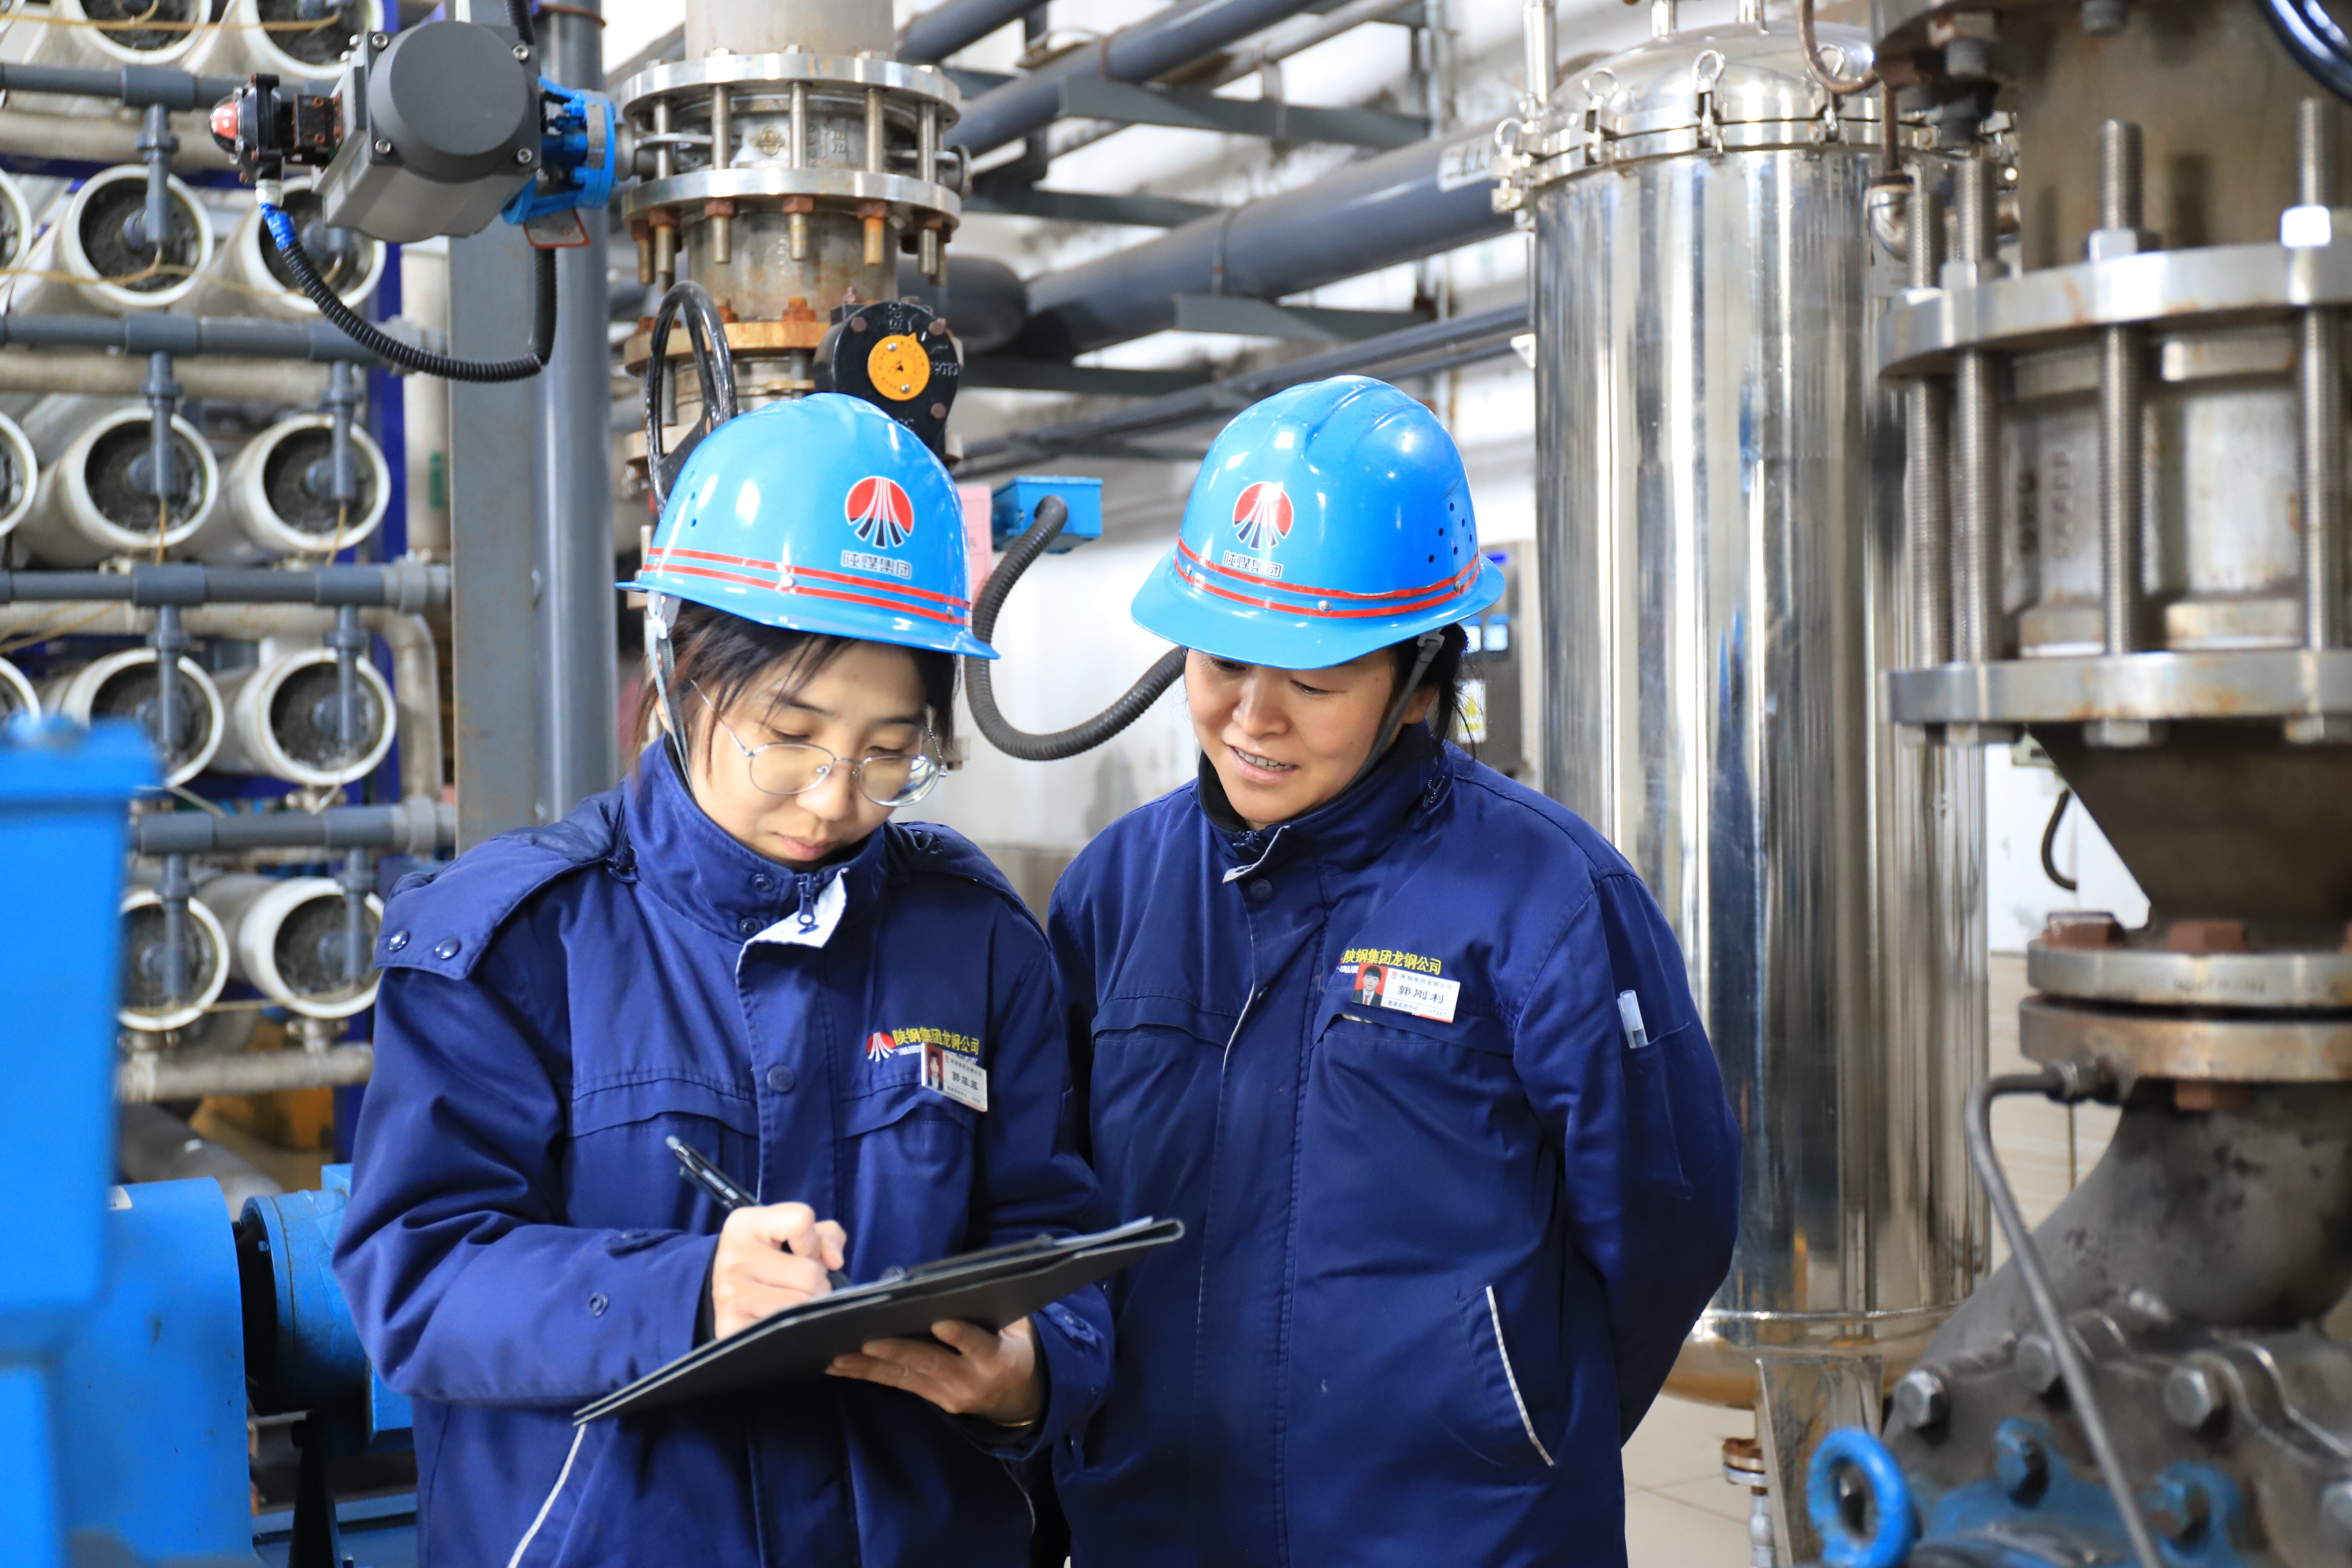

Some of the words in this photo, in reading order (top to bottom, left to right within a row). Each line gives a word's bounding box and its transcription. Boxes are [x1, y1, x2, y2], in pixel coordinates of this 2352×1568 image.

[1223, 551, 1282, 578] 陕煤集团
[1343, 948, 1442, 975] 陕钢集团龙钢公司
[1396, 985, 1444, 1003] 郭刚利
[1400, 974, 1452, 989] 陕钢集团龙钢公司
[892, 1027, 979, 1055] 陕钢集团龙钢公司
